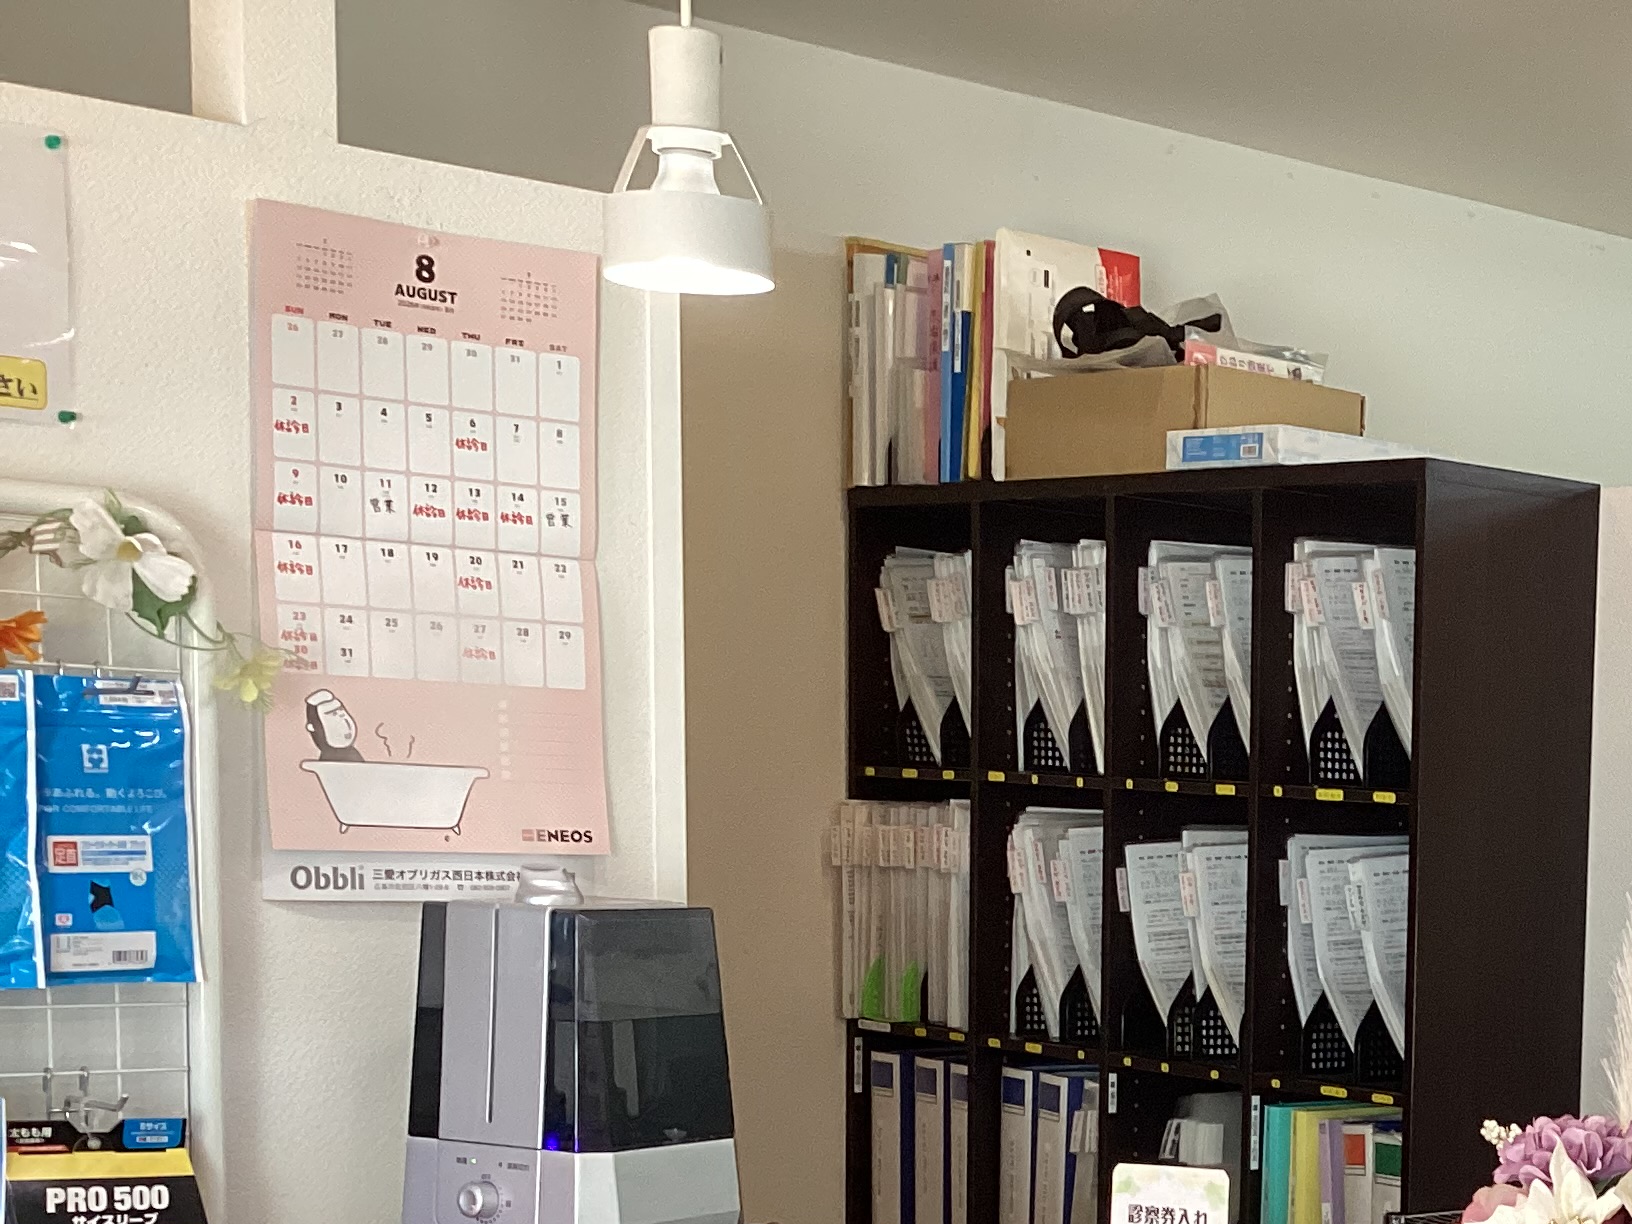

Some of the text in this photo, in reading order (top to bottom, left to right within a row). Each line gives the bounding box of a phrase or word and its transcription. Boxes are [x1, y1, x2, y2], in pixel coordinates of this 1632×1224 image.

[415, 254, 435, 283] 8
[395, 283, 457, 305] AUGUST
[329, 312, 348, 322] MON
[373, 319, 392, 329] TUE
[461, 332, 481, 341] THU
[505, 338, 524, 347] FRI
[556, 360, 562, 370] 1
[290, 396, 297, 406] 2
[335, 402, 342, 412] 3
[380, 408, 388, 417] 4
[425, 413, 432, 423] 5
[469, 419, 476, 428] 6
[513, 423, 519, 433] 7
[292, 469, 567, 507] 9 10 11 12 13 14 15
[288, 540, 567, 574] 16 17 18 19 20 21 22
[292, 611, 572, 640] 23 24 25 26 27 28 29
[340, 648, 353, 657] 31
[536, 829, 593, 843] ENEOS
[290, 865, 365, 891] Obbli
[46, 1184, 170, 1214] PRO 500
